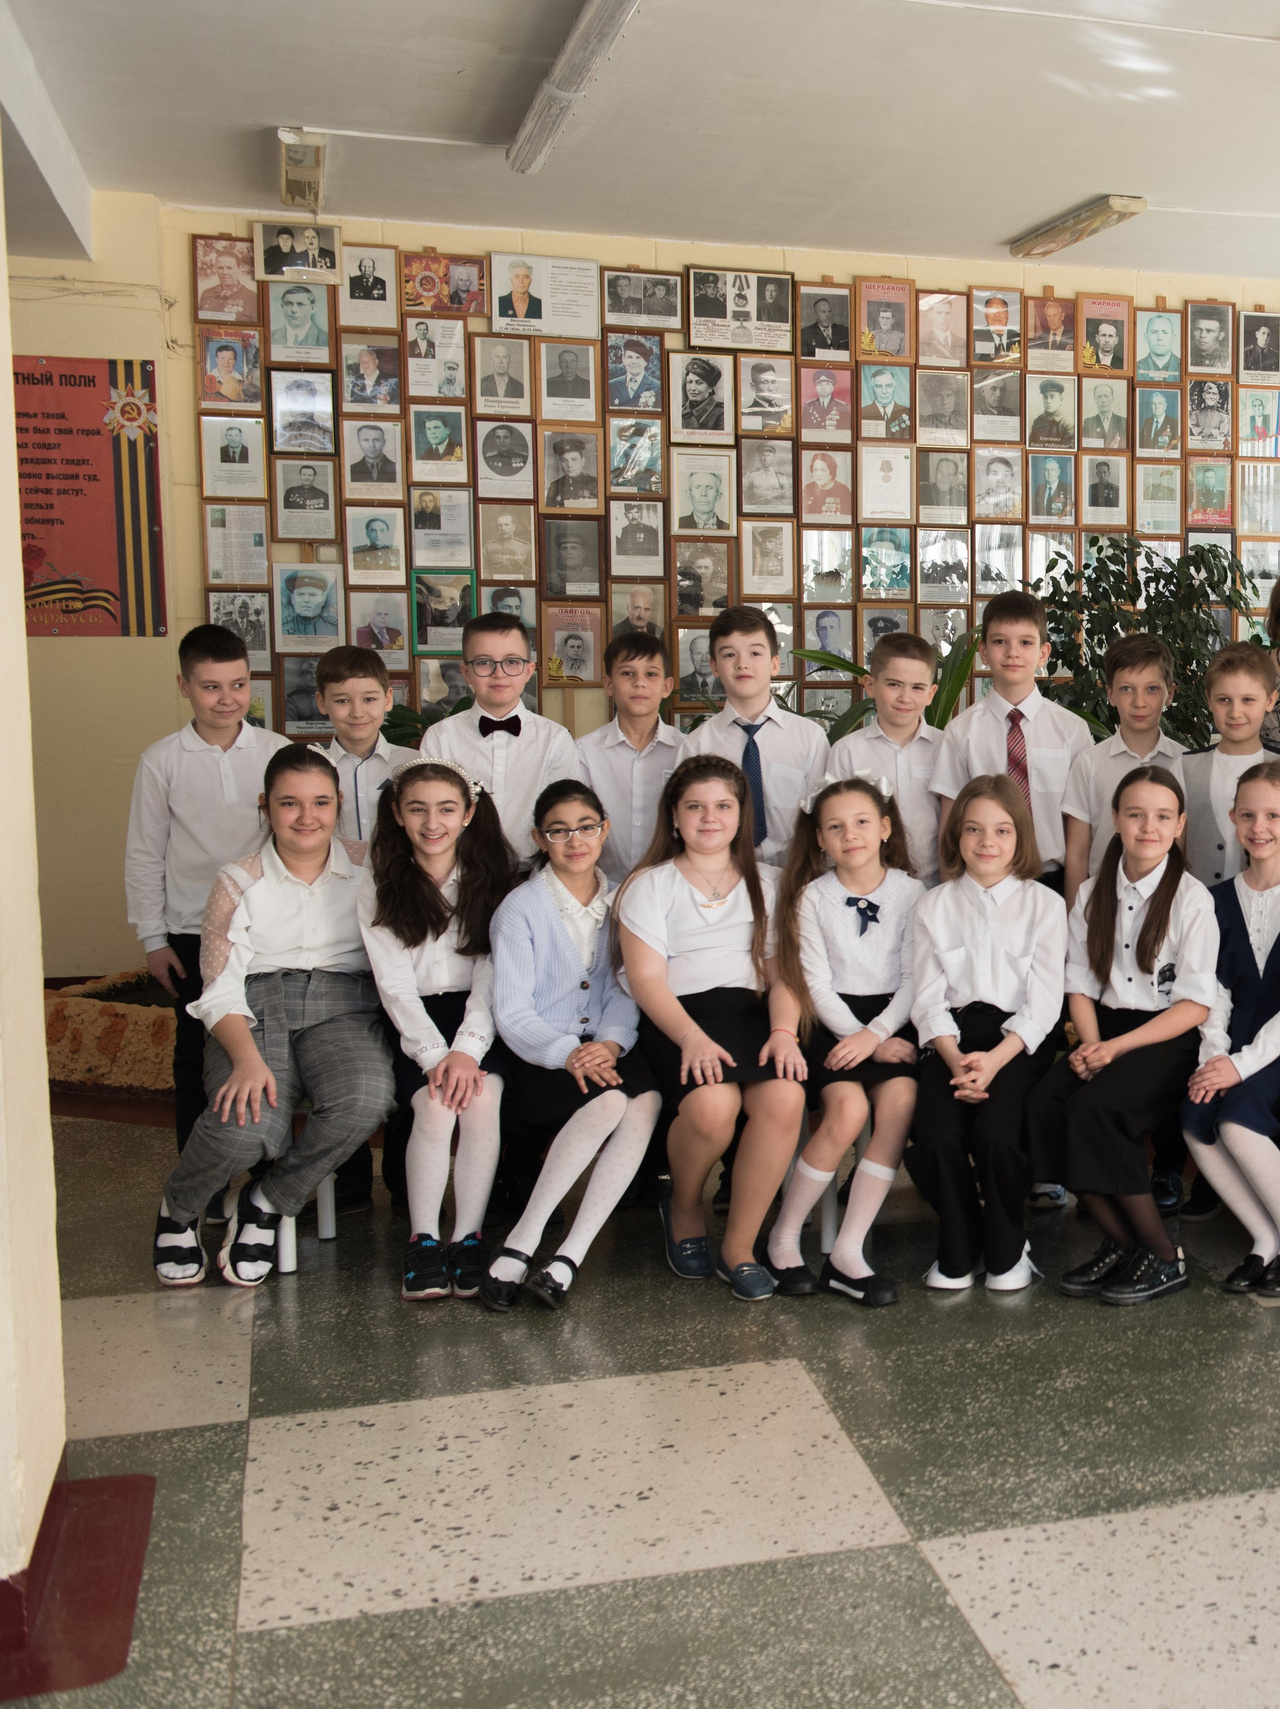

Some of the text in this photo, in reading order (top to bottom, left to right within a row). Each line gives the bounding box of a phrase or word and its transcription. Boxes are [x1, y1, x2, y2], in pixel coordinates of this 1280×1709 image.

[865, 284, 906, 292] ЩЕРБАКОВ
[59, 374, 97, 388] ПОЛК
[204, 374, 217, 394] 9
[16, 411, 38, 419] емьи
[33, 425, 51, 435] был
[54, 427, 74, 436] свой
[76, 427, 104, 437] герой.
[32, 442, 62, 451] солдат
[20, 457, 94, 467] увядших глядят.
[45, 472, 80, 481] высший
[25, 486, 54, 496] сейчас
[24, 502, 55, 510] нельзя
[24, 516, 65, 527] обмануть
